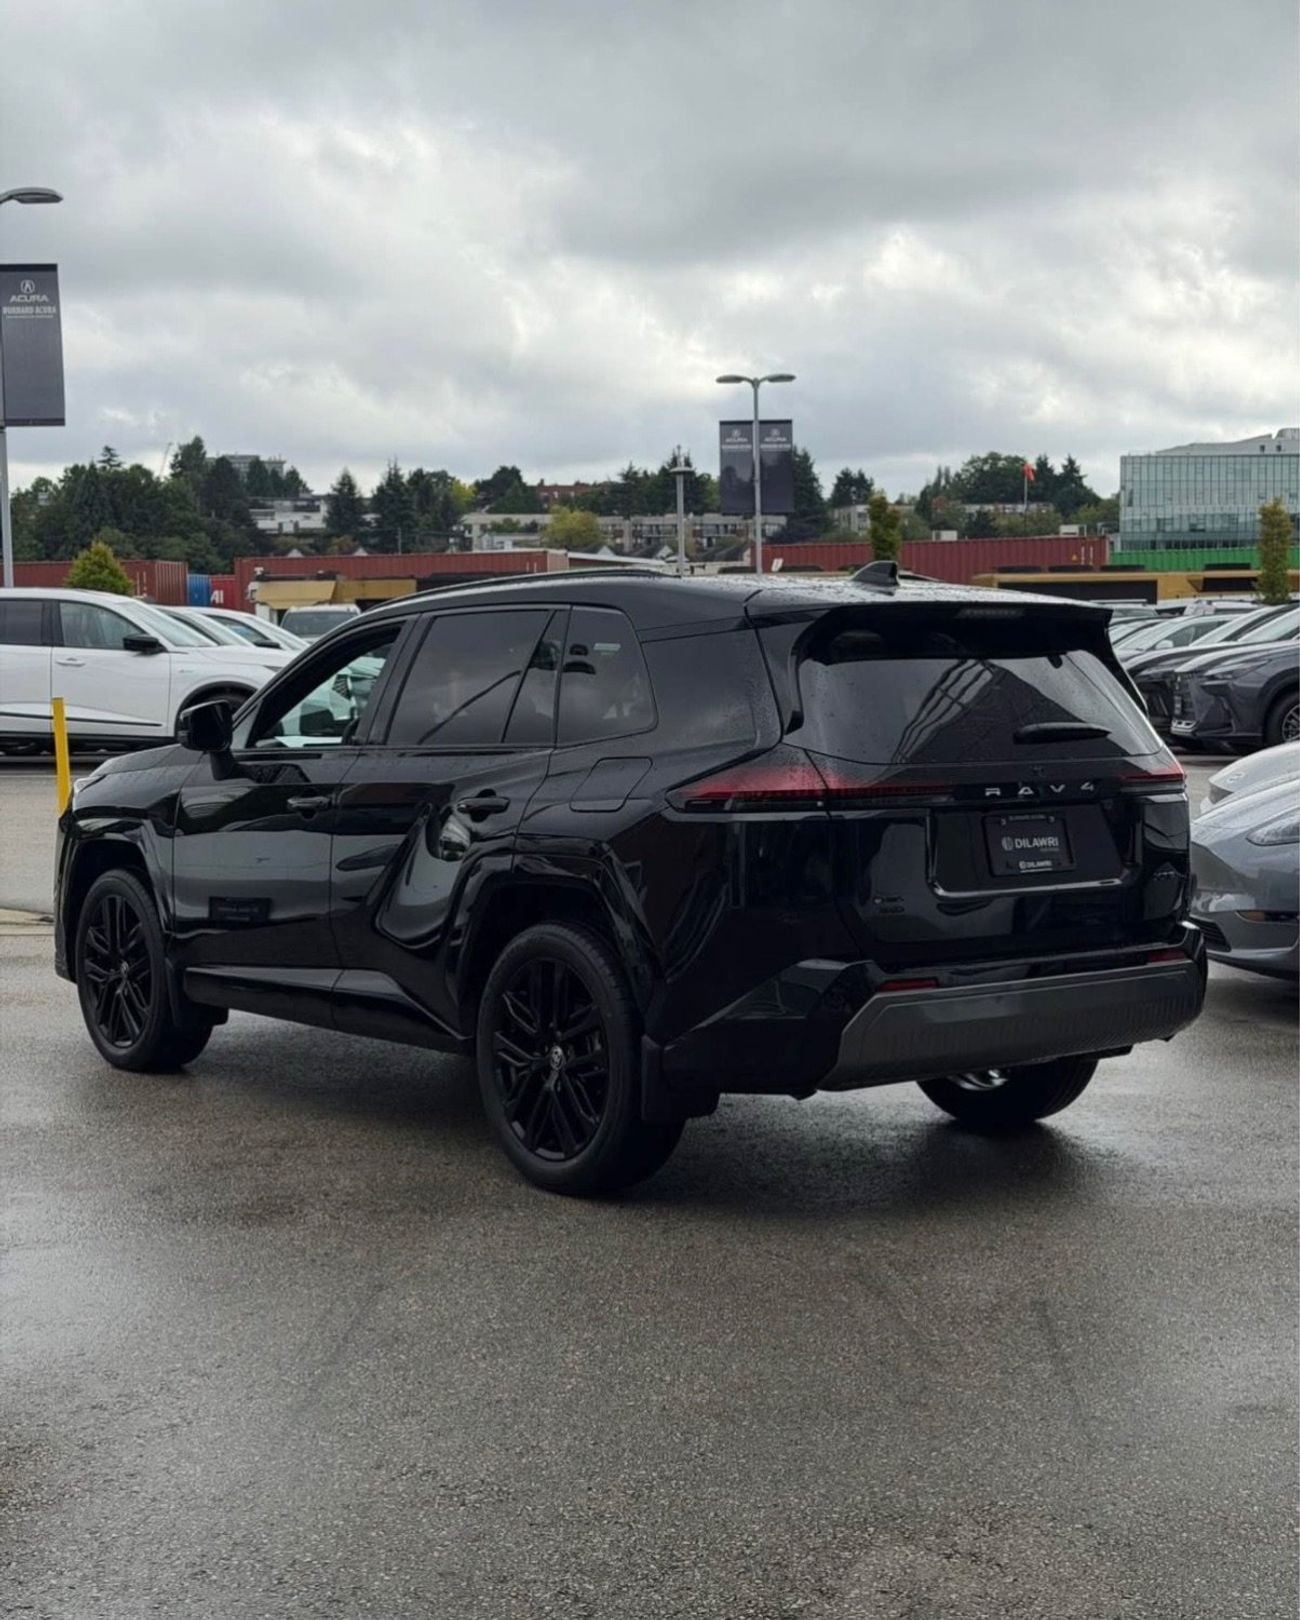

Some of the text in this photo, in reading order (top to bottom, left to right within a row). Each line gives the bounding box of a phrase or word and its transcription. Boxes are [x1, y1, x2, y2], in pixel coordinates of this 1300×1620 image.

[9, 294, 49, 303] ACURA
[984, 780, 1095, 797] RAV4
[1014, 836, 1060, 849] DILAWRI
